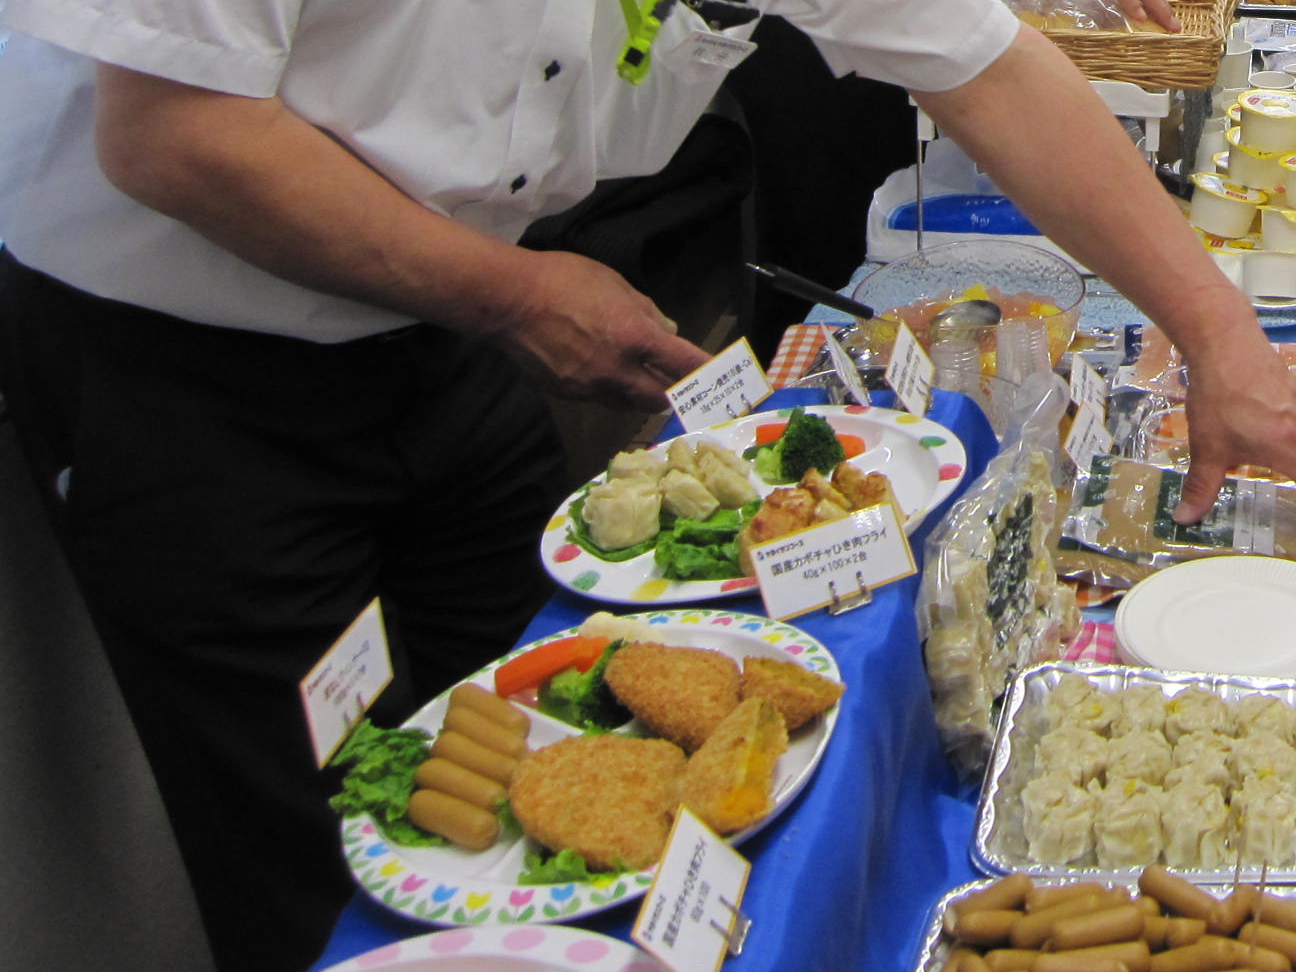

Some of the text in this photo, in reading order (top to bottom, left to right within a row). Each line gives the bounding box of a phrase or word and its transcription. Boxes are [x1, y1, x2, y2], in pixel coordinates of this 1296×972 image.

[770, 527, 888, 577] 国産カボチャひき肉フライ
